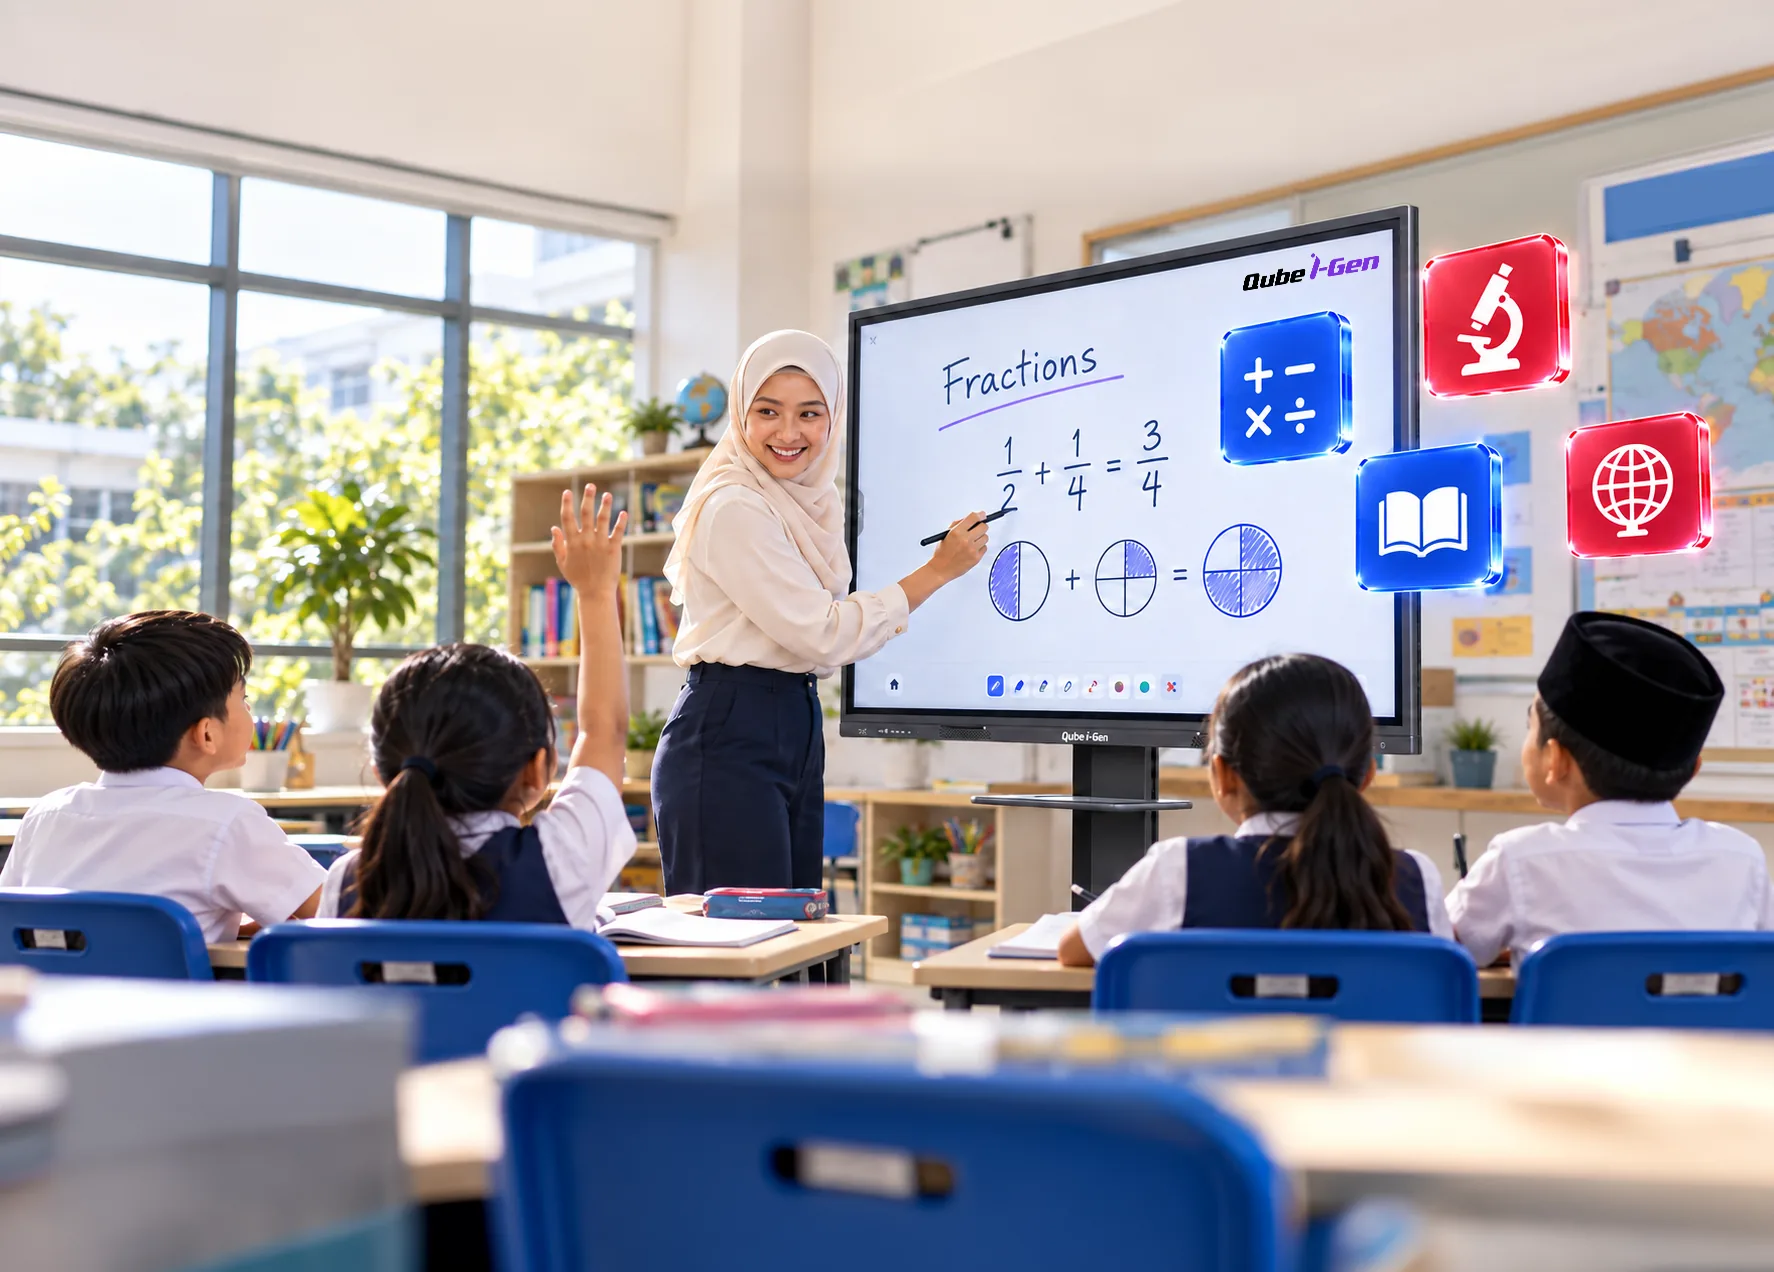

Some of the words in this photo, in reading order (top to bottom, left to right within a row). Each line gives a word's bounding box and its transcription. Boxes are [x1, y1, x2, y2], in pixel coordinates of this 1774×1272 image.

[1242, 266, 1306, 292] Qube
[942, 347, 1098, 406] Fractions
[1142, 419, 1162, 452] 3
[1067, 474, 1088, 512] 4
[1141, 469, 1163, 508] 4
[1061, 731, 1085, 743] Qube
